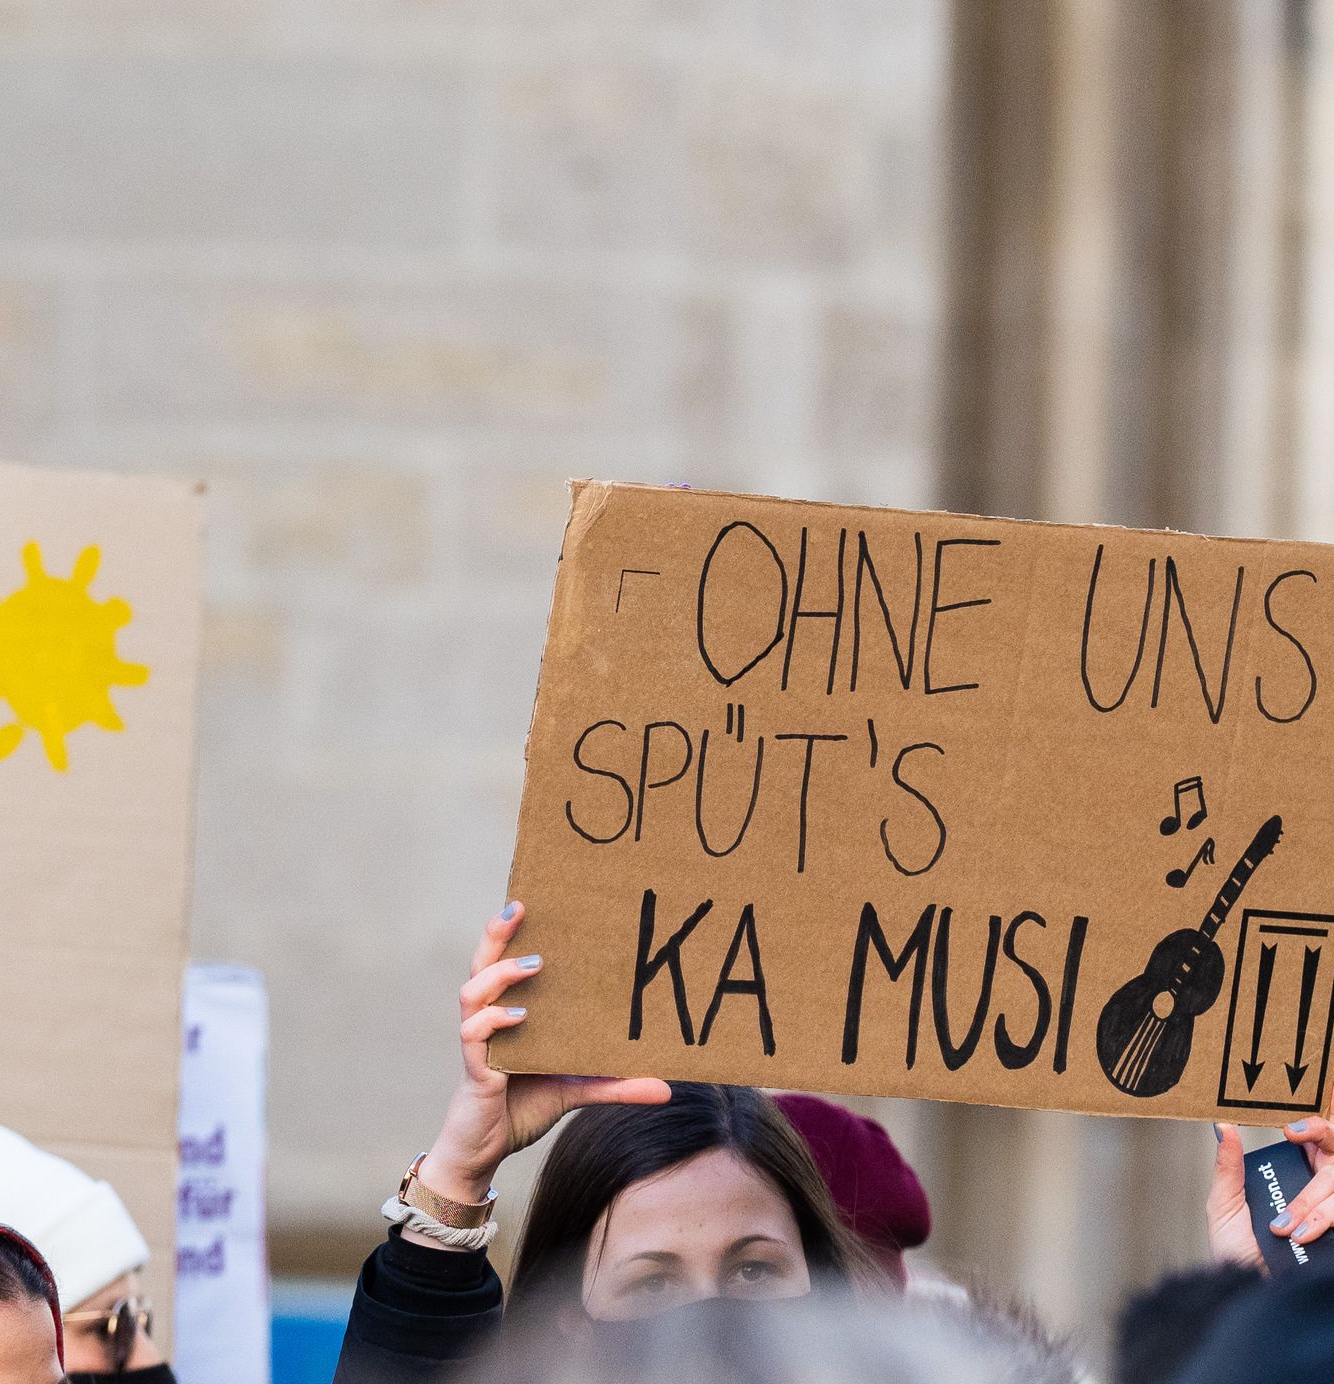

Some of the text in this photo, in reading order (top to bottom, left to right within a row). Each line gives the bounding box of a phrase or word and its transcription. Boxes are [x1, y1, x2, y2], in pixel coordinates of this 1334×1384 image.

[696, 520, 1318, 725] OHNE UNS
[564, 702, 948, 877] SPÜT'S
[627, 887, 1090, 1075] KA MUSI
